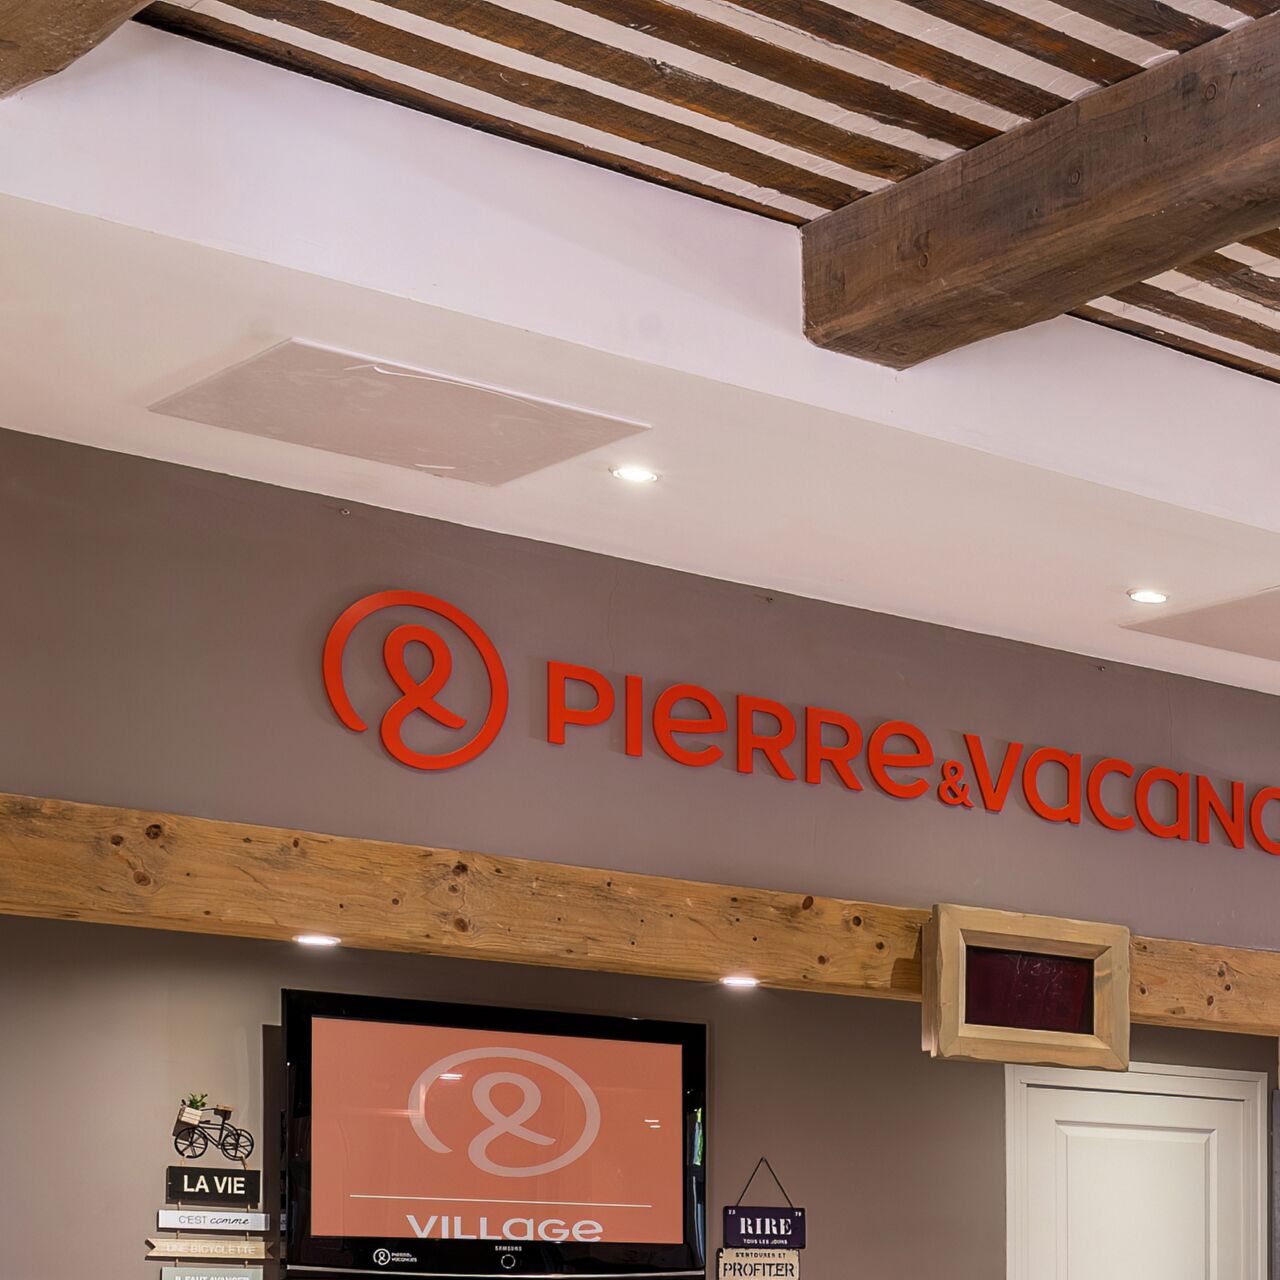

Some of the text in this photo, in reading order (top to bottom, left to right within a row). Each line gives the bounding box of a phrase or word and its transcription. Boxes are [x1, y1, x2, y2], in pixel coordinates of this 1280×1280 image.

[183, 1174, 246, 1195] LA VIE
[178, 1215, 250, 1226] C'EST comme
[740, 1217, 792, 1235] RIRE
[191, 1245, 257, 1255] BICYCLETTE
[723, 1262, 795, 1277] PROFITER
